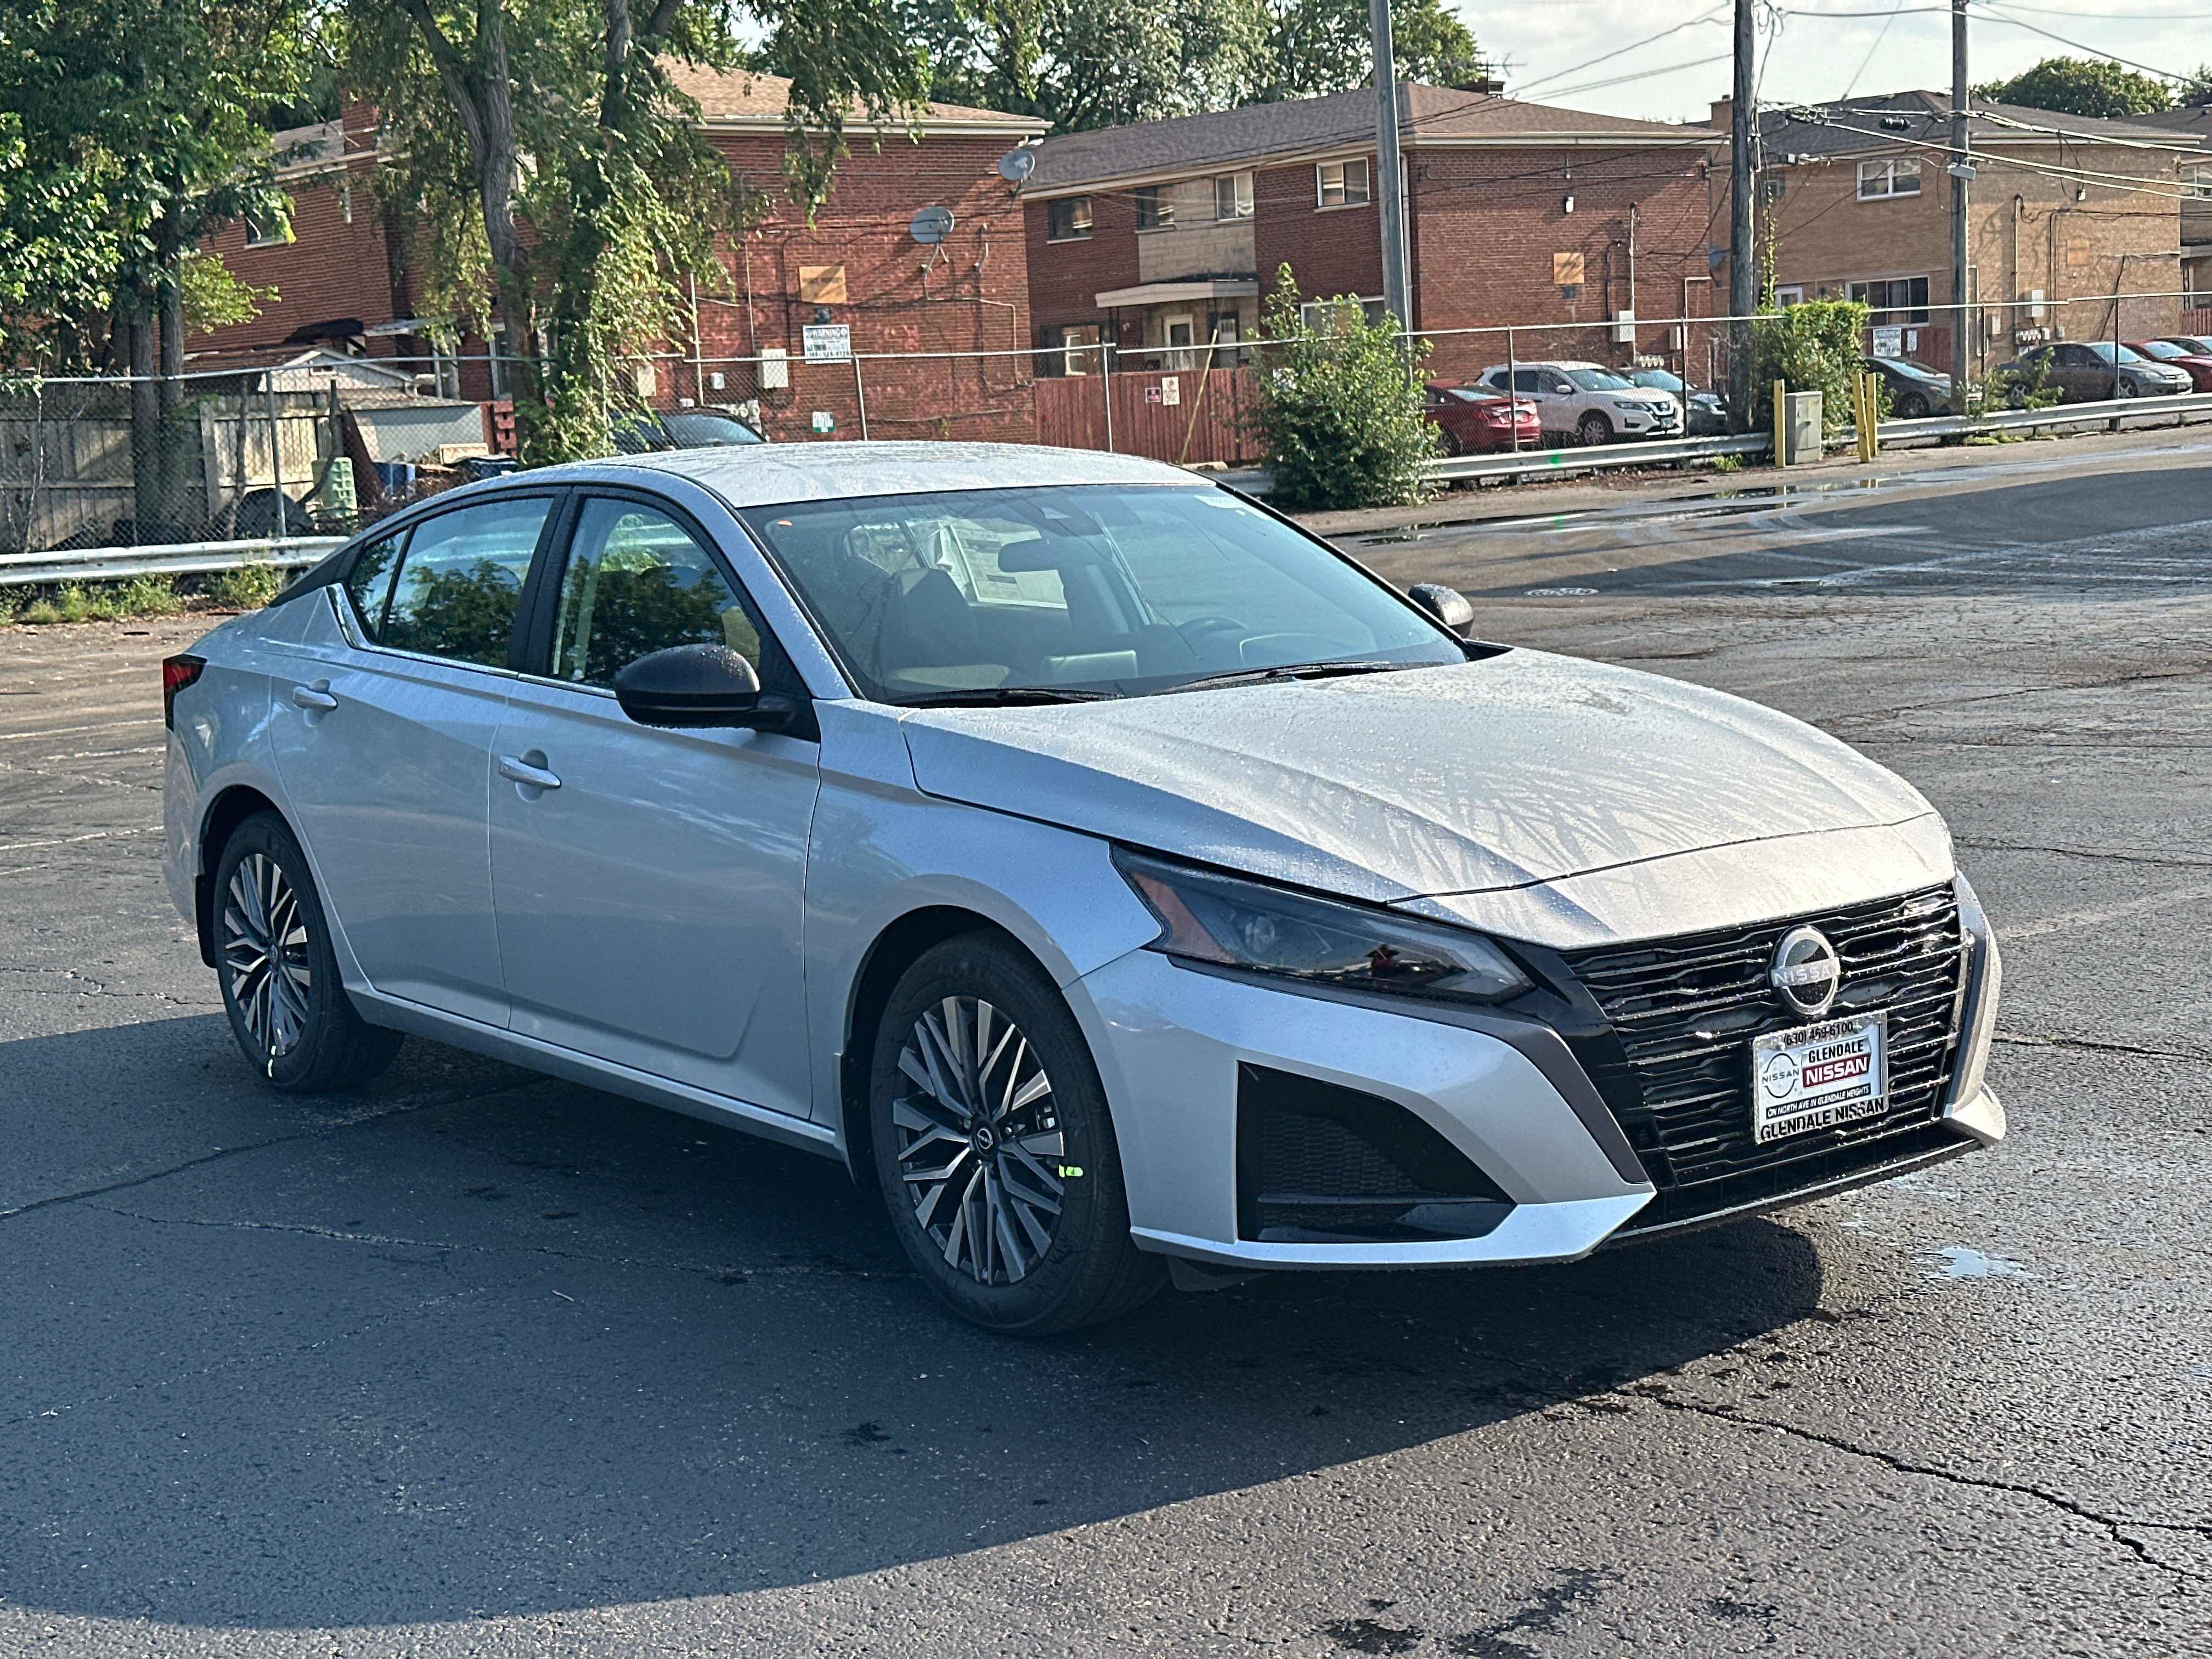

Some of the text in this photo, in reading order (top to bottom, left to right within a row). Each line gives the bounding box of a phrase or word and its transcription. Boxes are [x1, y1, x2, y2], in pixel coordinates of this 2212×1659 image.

[1784, 1030, 1807, 1046] (630)
[1808, 1040, 1864, 1063] GLENDALE
[1762, 1068, 1799, 1084] NISSAN
[1805, 1057, 1869, 1085] NISSAN
[1768, 1085, 1870, 1116] ON NORTH AVE IN GLENDALE HEIGHTS
[1760, 1097, 1884, 1141] GLENDALE NISSAN
